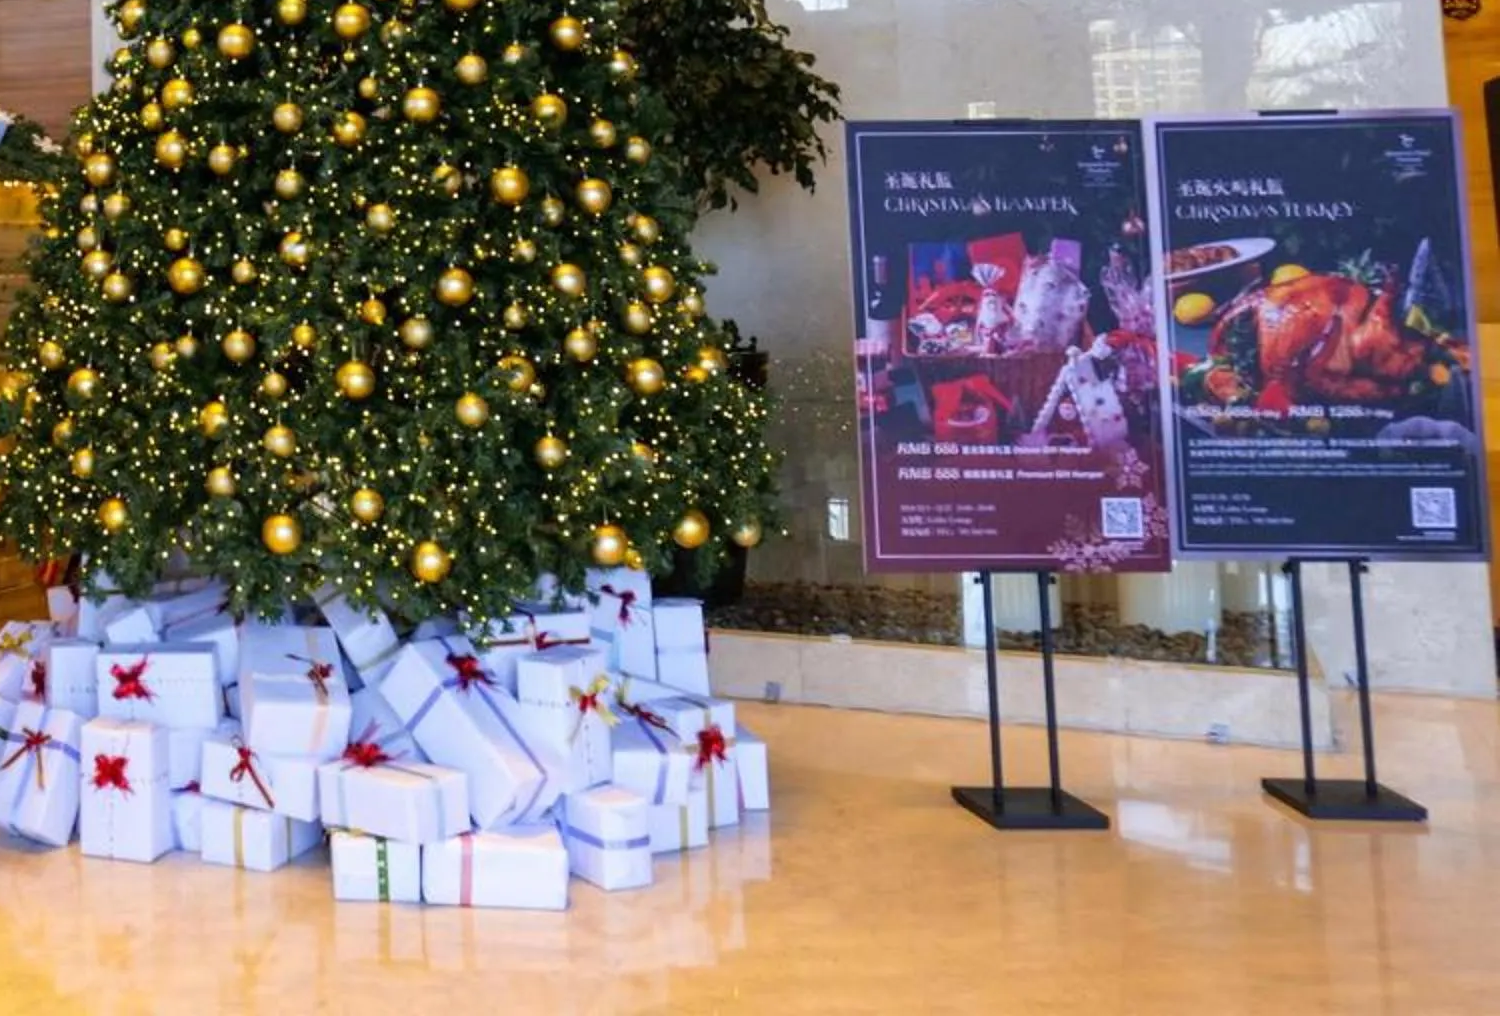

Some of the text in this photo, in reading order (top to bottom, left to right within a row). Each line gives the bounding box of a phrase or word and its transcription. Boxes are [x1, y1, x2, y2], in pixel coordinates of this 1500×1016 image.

[884, 196, 1078, 216] CHRISTMAS HAMPER
[1175, 201, 1354, 222] CHRISTMAS TURKEY
